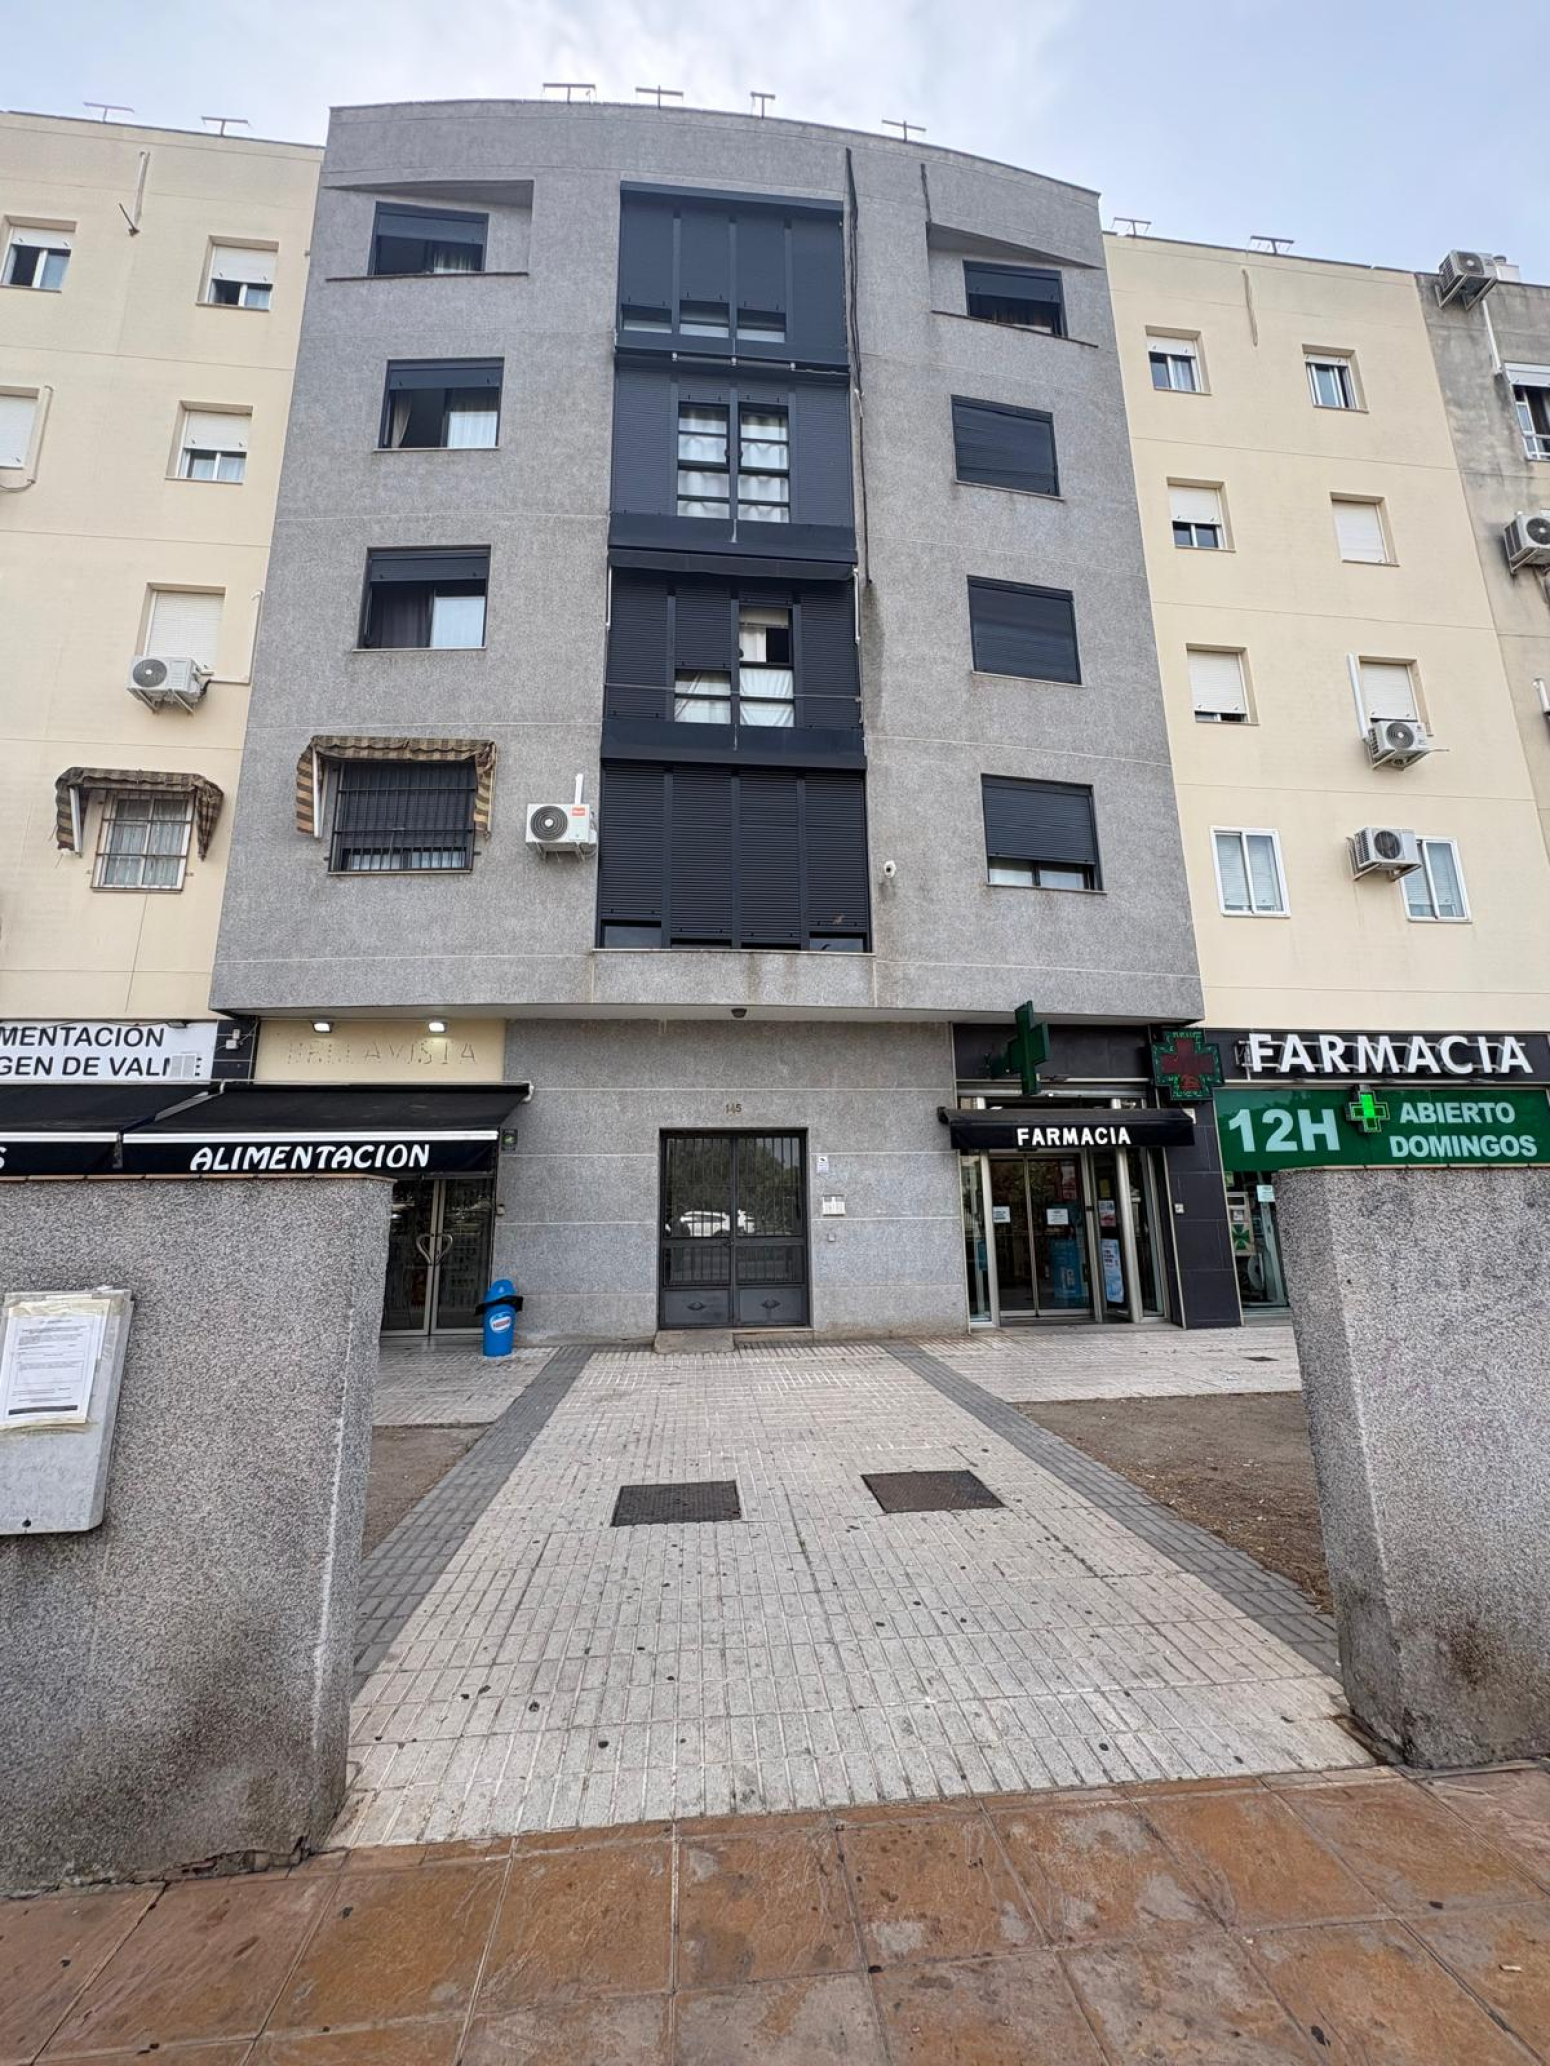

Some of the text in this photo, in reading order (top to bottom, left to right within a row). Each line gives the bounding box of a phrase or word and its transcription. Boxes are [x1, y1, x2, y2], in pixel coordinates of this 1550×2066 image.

[0, 1026, 165, 1047] MENTACION
[1249, 1033, 1534, 1074] FARMACIA
[62, 1056, 101, 1076] DE
[1400, 1102, 1515, 1124] ABIERTO
[1016, 1126, 1132, 1146] FARMACIA
[1228, 1109, 1341, 1153] 12H
[189, 1144, 430, 1171] ALIMENTACION
[1389, 1135, 1538, 1158] DOMINGOS
